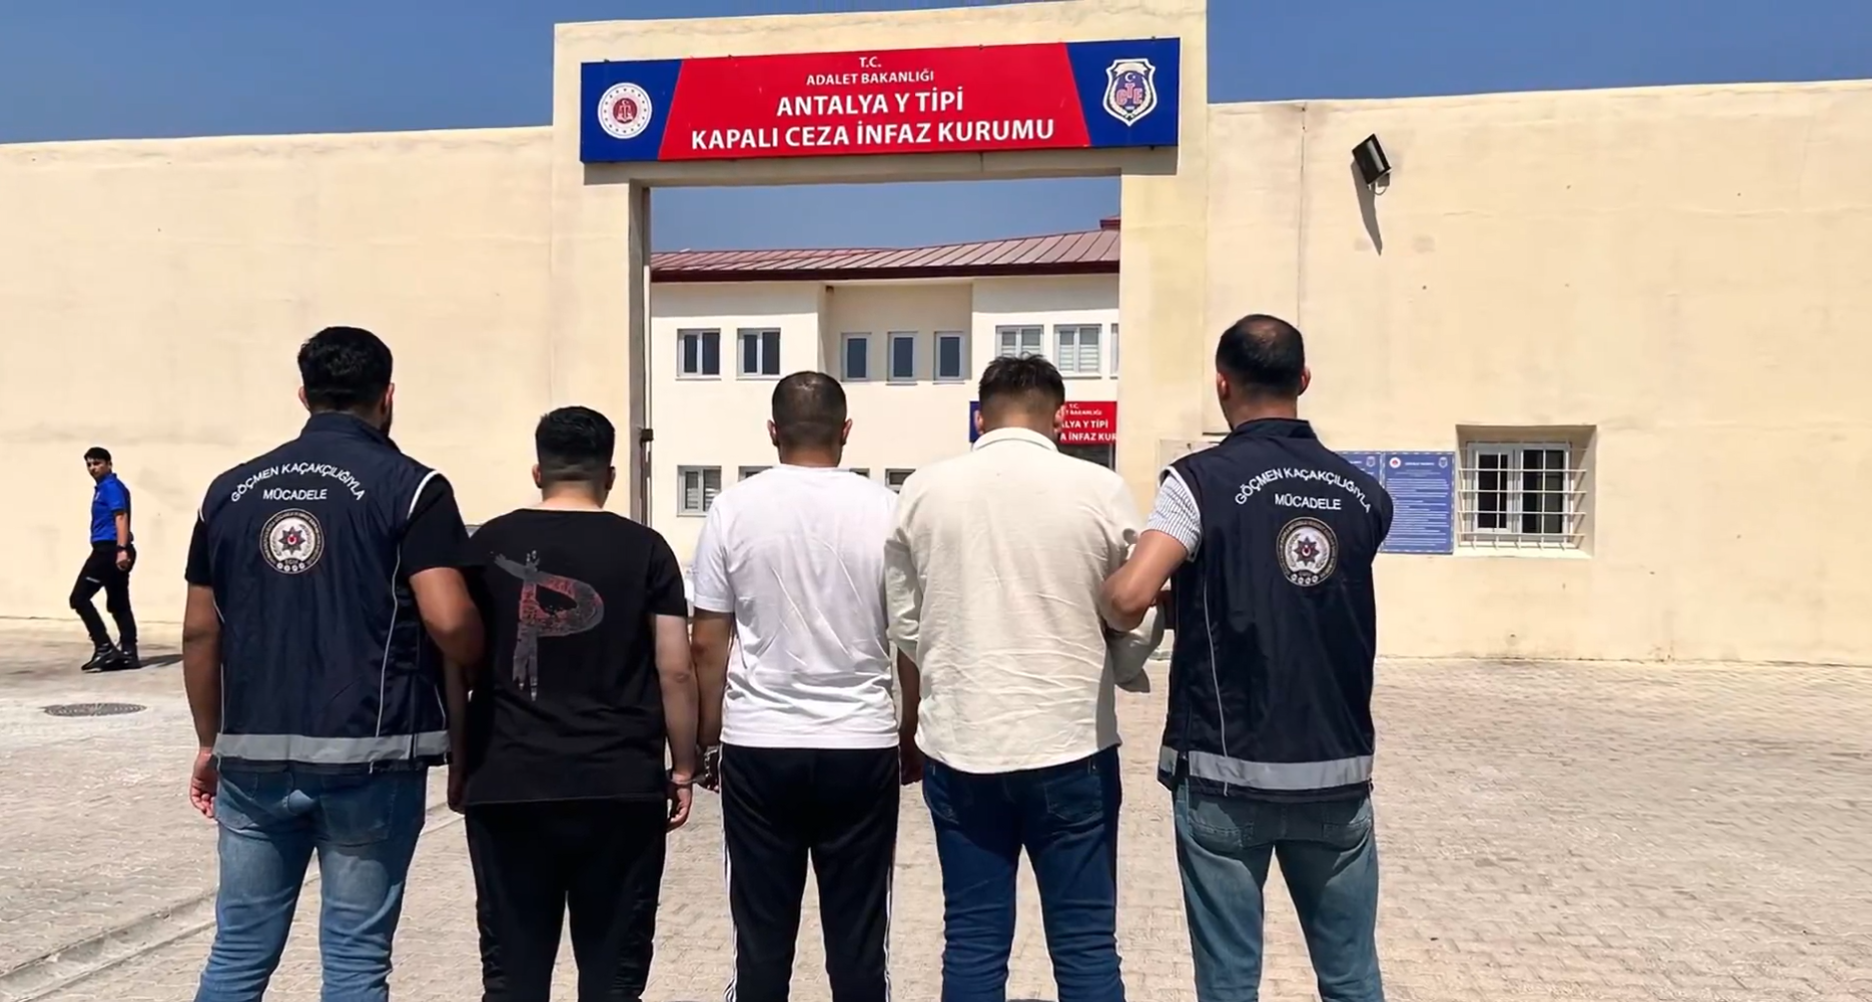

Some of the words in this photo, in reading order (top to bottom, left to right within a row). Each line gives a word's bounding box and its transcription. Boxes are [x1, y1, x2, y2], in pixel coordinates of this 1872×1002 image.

[859, 57, 882, 68] T.C.
[806, 73, 858, 86] ADALET
[861, 68, 934, 84] BAKANLIĞI
[776, 94, 888, 117] ANTALYA
[895, 93, 910, 113] Y
[915, 86, 963, 112] TİPİ
[692, 127, 779, 150] KAPALI
[785, 126, 850, 146] CEZA
[856, 120, 931, 144] İNFAZ
[938, 119, 1054, 142] KURUMU
[1083, 420, 1089, 428] Y
[1091, 419, 1109, 428] TİPİ
[1069, 431, 1097, 440] İNFAZ
[231, 466, 279, 502] GÖÇMEN
[281, 462, 365, 501] KAÇAKÇILIĞIYLA
[1234, 468, 1283, 505] GÖÇMEN
[262, 488, 328, 500] MÜCADELE
[1274, 493, 1342, 510] MÜCADELE
